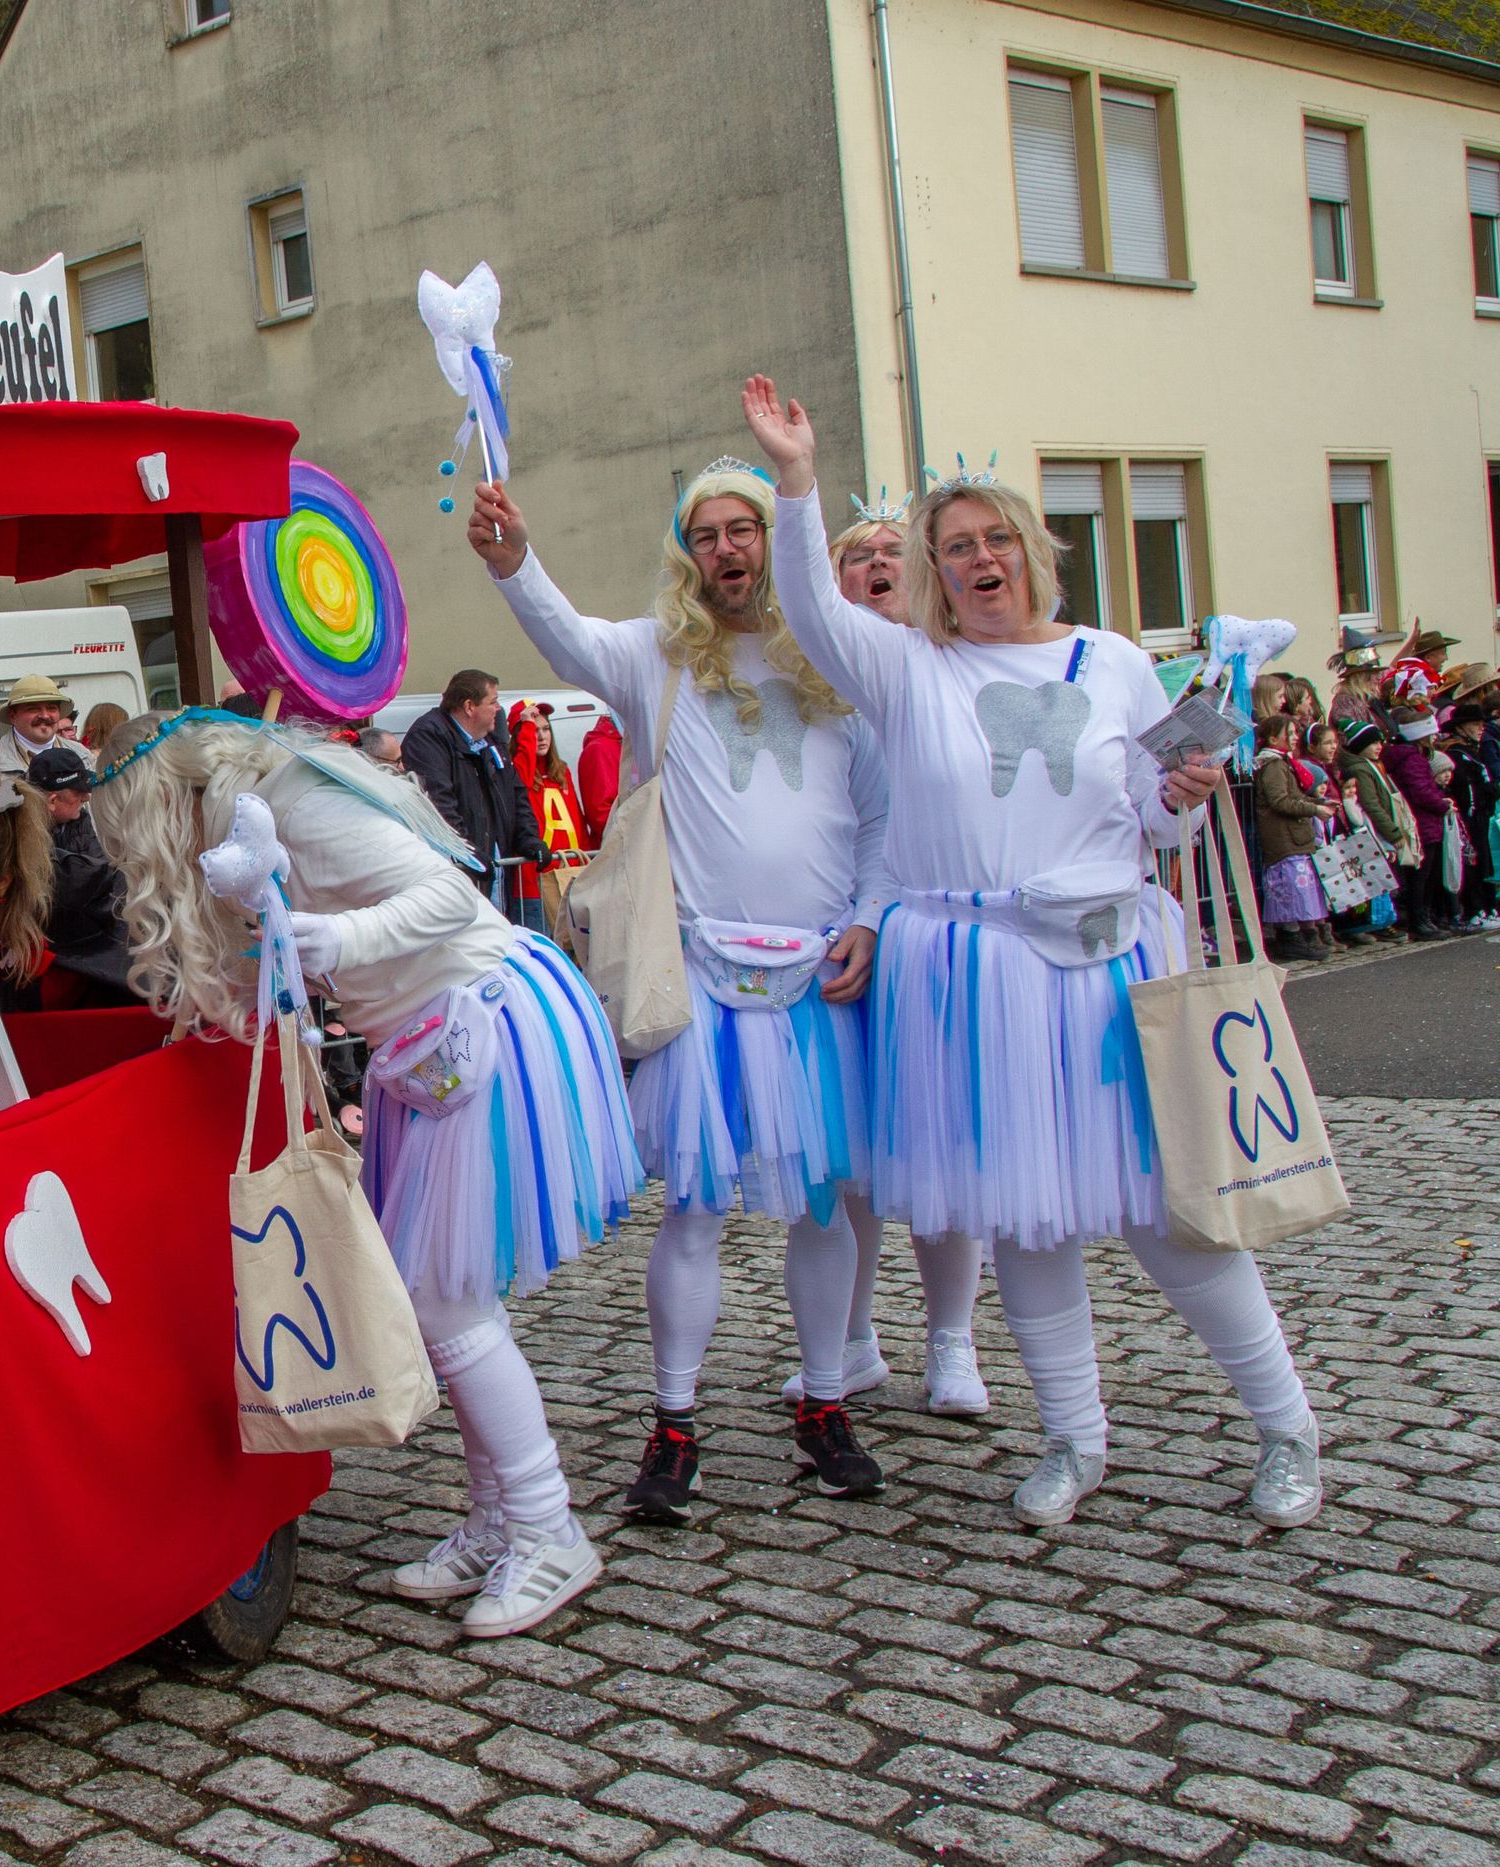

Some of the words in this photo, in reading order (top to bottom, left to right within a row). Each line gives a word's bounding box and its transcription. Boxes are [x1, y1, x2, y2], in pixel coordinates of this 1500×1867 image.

[73, 642, 125, 654] FLEURETTE
[543, 787, 580, 851] A
[240, 1386, 376, 1417] aximini-wallerstein.de
